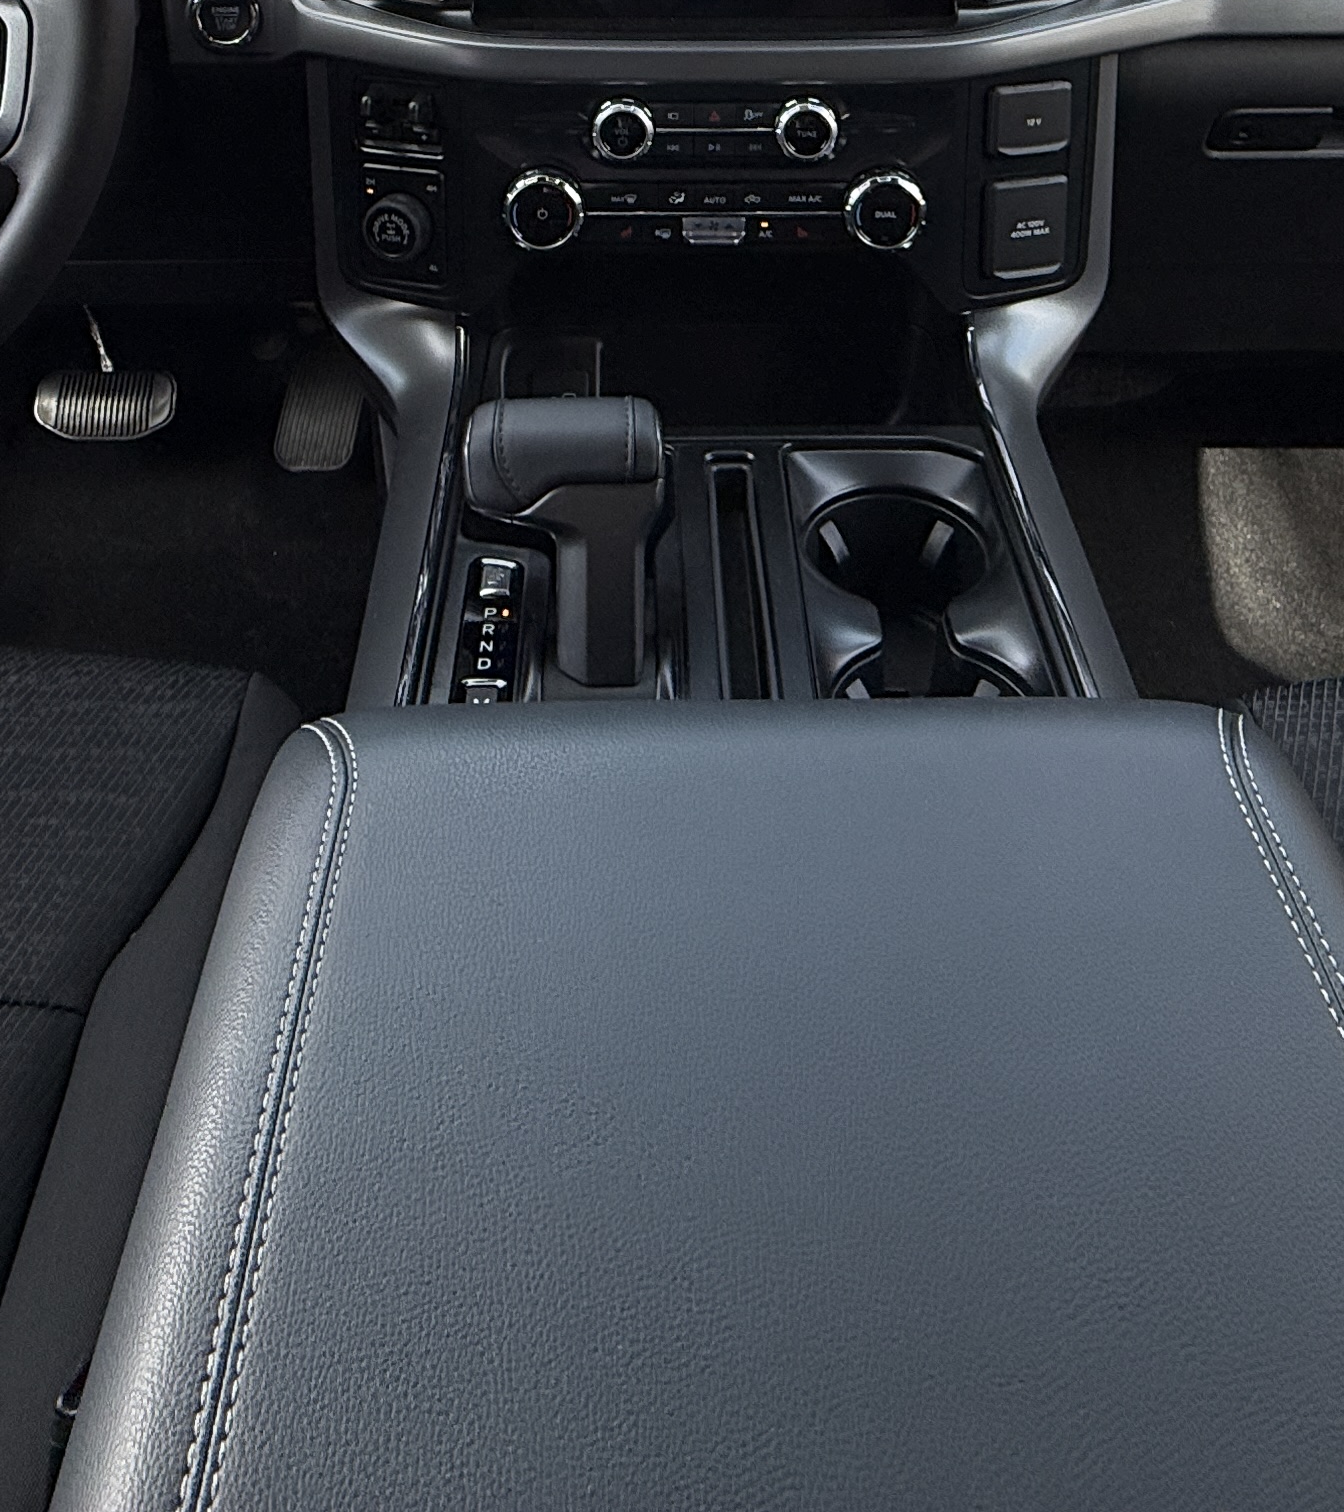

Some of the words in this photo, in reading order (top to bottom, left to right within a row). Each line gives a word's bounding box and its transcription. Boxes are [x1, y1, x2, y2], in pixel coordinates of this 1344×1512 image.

[703, 196, 727, 204] AUTO
[788, 195, 806, 203] MAX
[807, 195, 823, 203] A/C
[874, 211, 897, 219] DUAL
[759, 230, 773, 238] A/C
[484, 607, 497, 619] P
[482, 624, 495, 635] R
[479, 640, 493, 653] N
[477, 657, 492, 670] D
